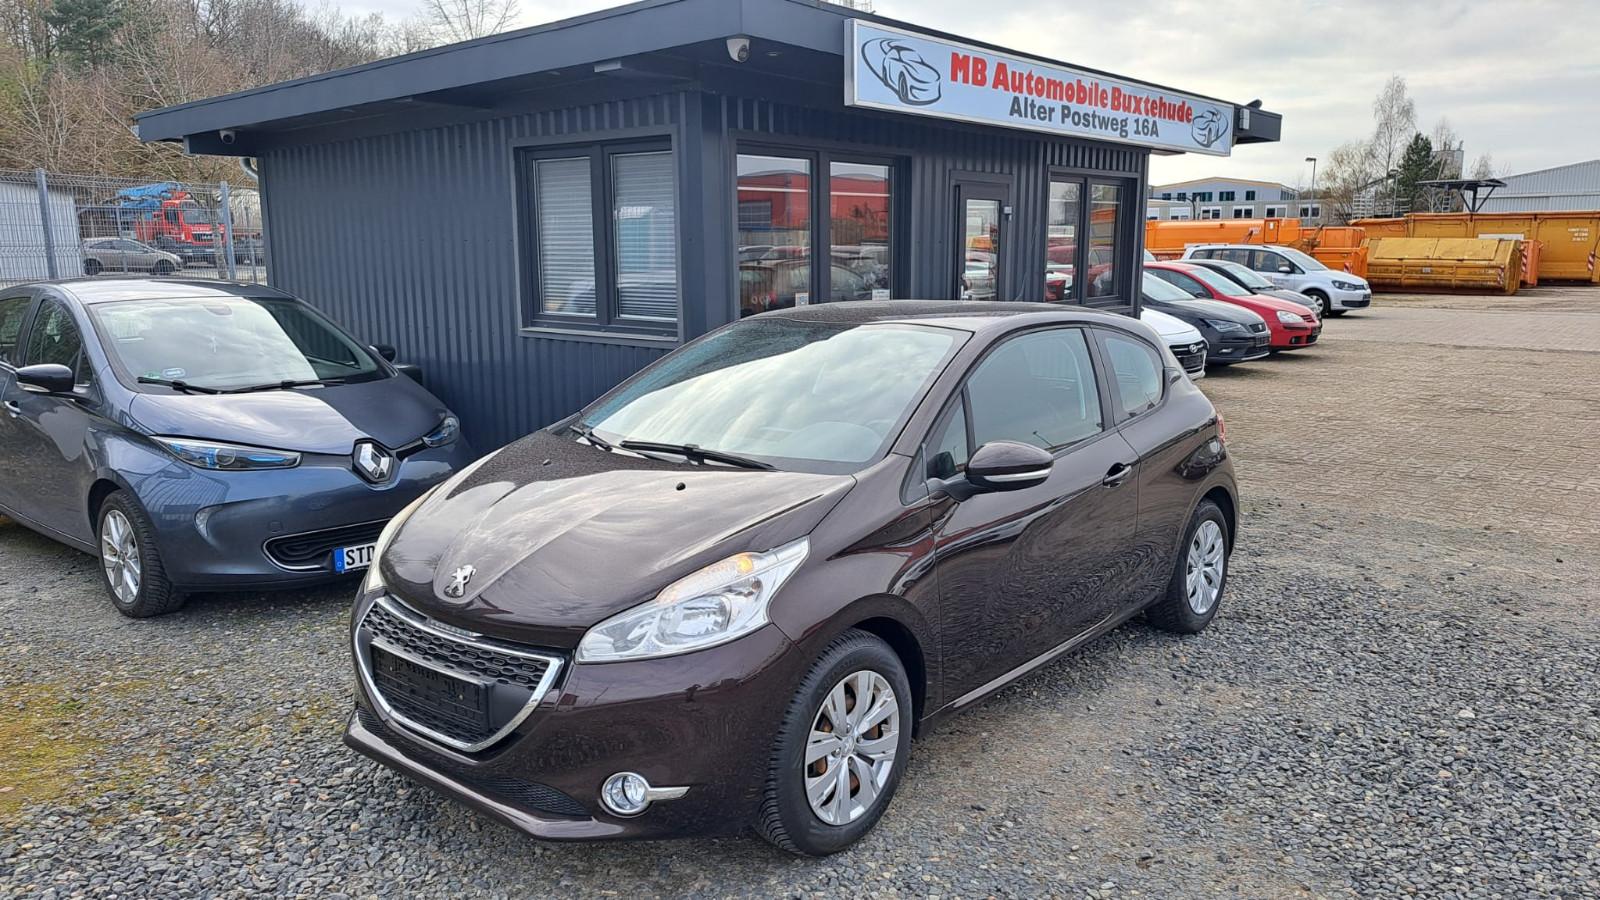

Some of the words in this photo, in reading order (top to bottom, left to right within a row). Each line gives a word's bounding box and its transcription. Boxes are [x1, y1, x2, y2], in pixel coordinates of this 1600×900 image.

[950, 52, 988, 87] MB
[992, 62, 1109, 108] Automobile
[1111, 86, 1193, 124] Buxtehude
[1009, 95, 1055, 122] Alter
[1061, 104, 1129, 138] Postweg
[1134, 118, 1159, 138] 16A
